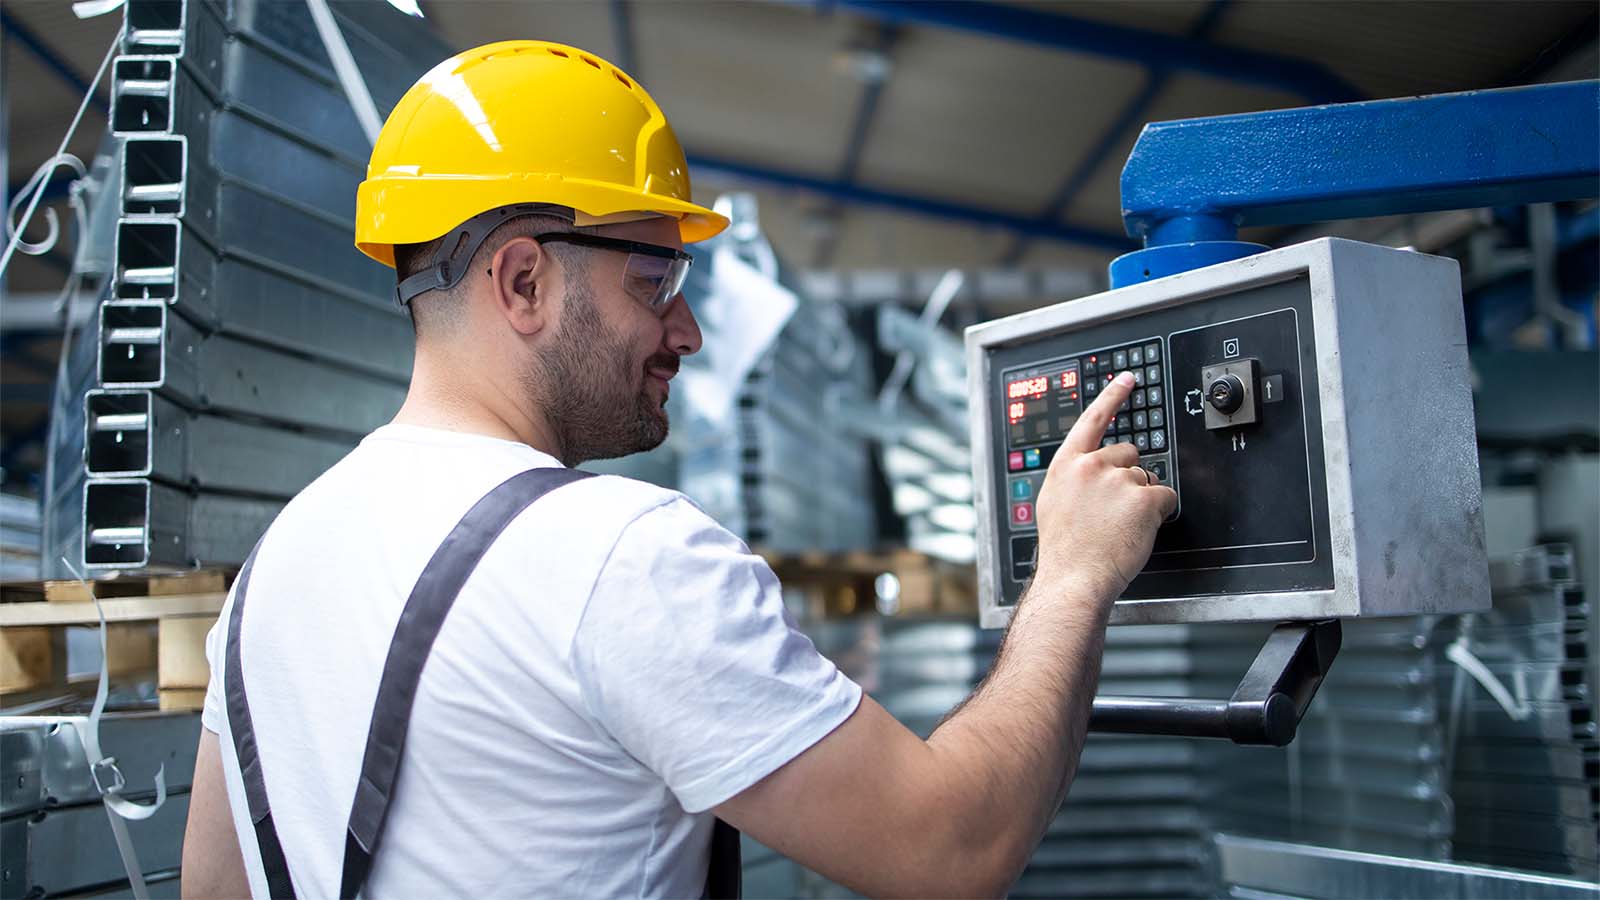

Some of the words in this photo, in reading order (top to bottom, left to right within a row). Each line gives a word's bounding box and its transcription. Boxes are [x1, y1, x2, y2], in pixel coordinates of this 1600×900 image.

[1150, 369, 1157, 380] 6
[1136, 394, 1142, 404] 2
[1138, 436, 1145, 446] C
